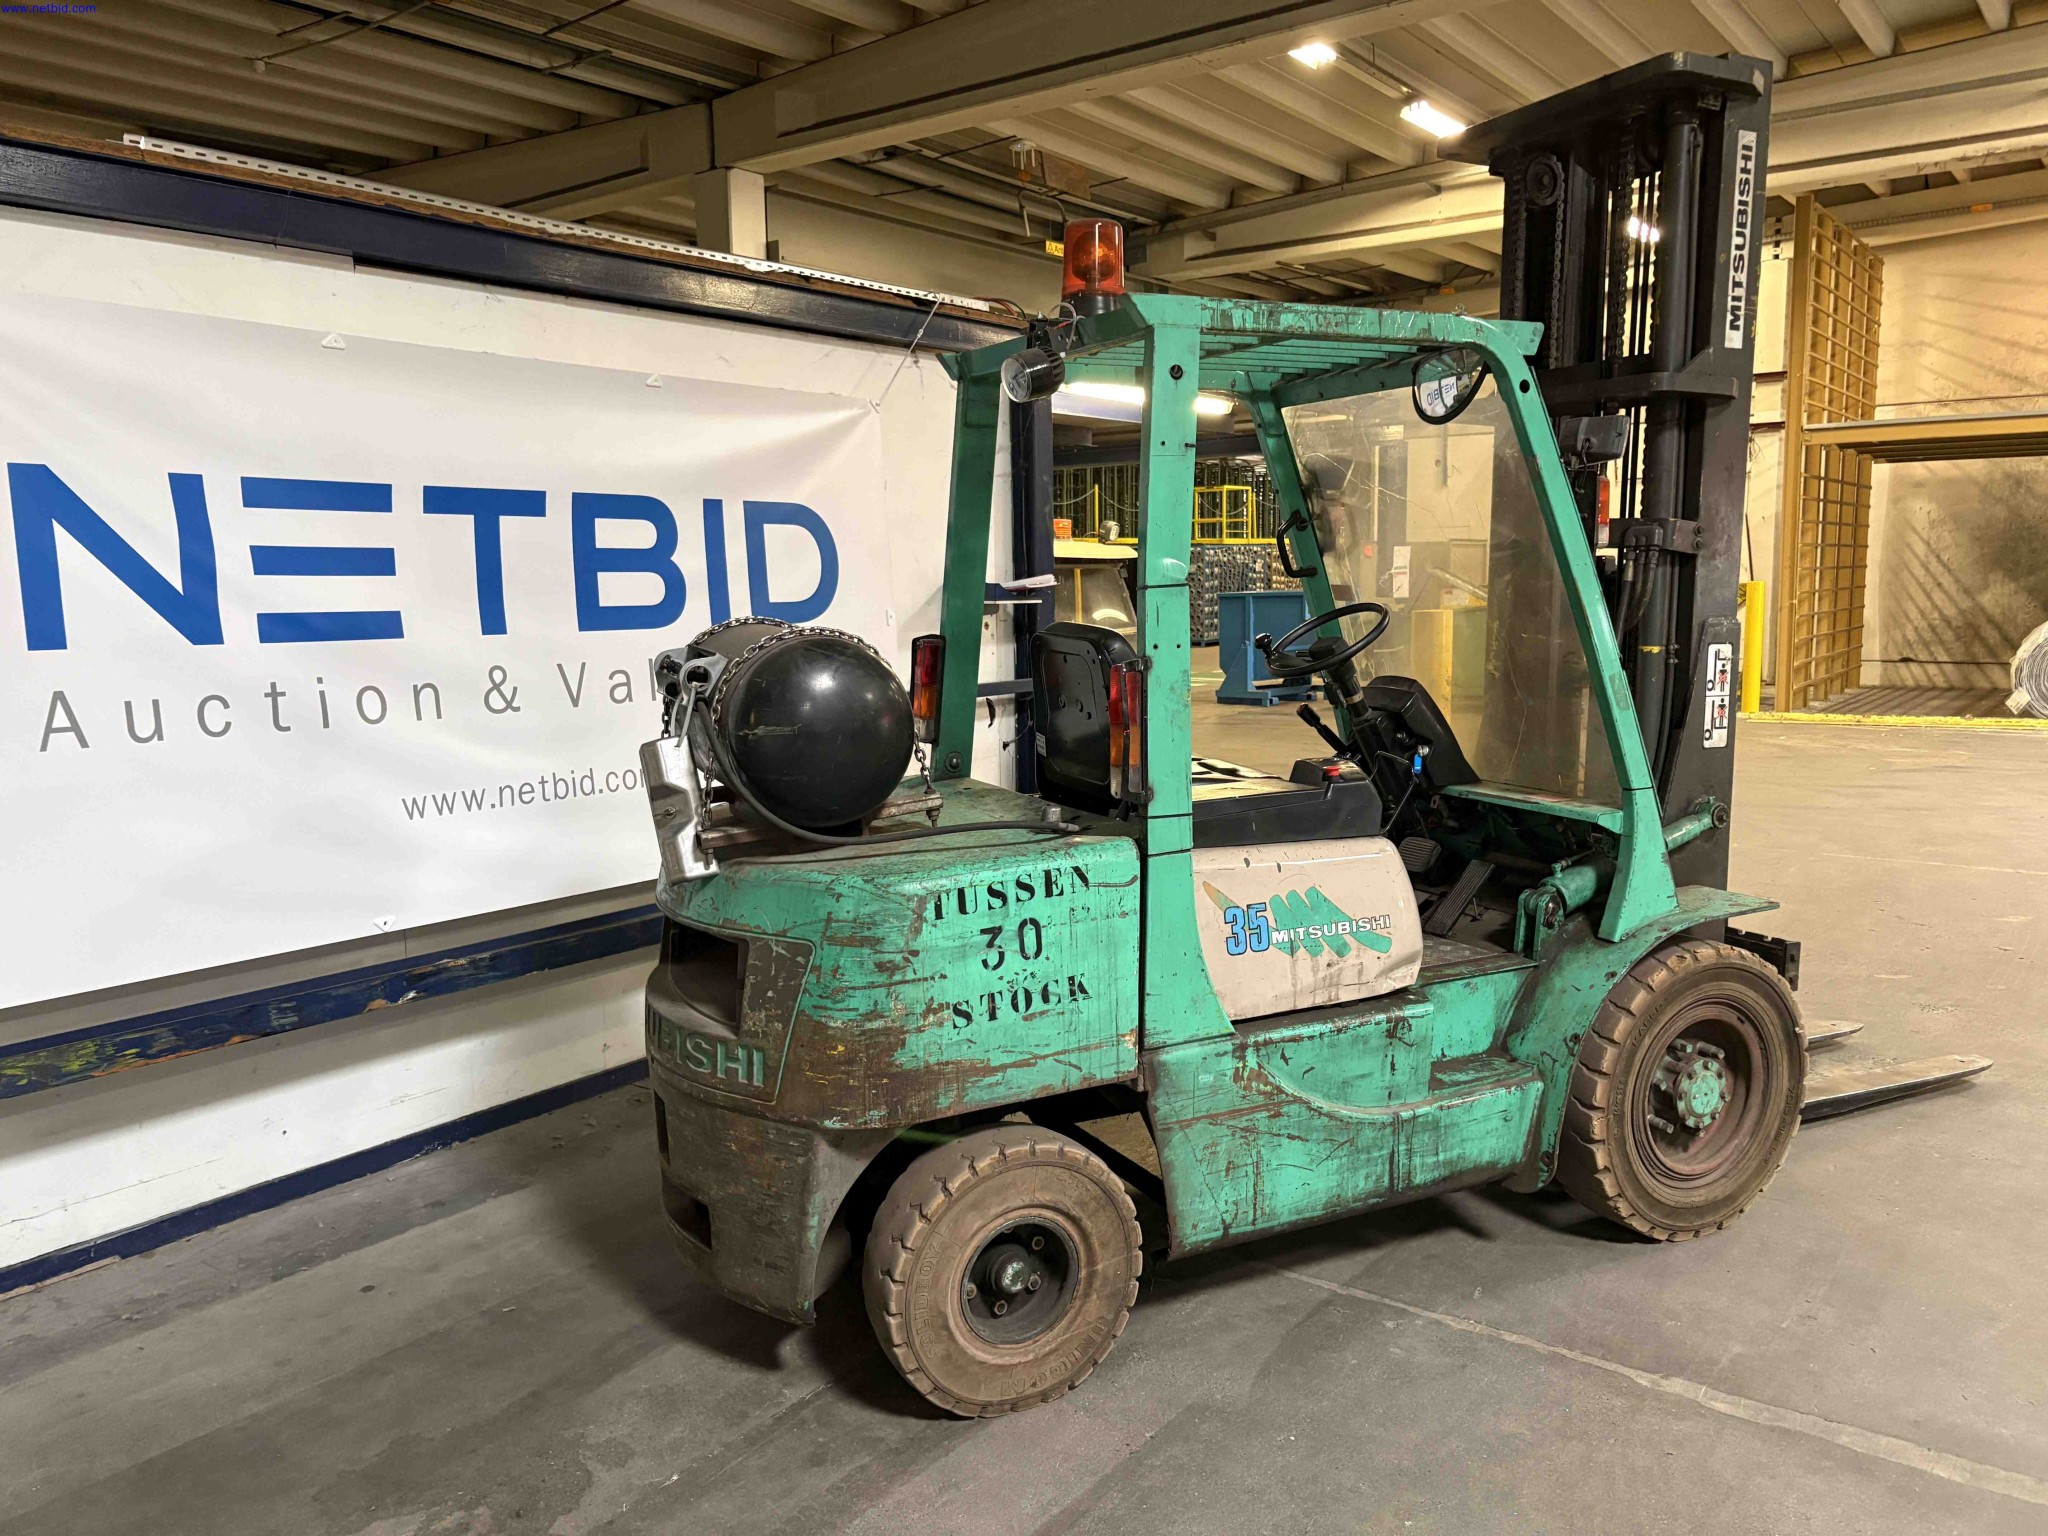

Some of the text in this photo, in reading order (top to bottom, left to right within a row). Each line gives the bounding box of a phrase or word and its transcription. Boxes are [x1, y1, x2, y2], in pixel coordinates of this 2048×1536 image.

[1729, 143, 1754, 332] MITSUBISHI
[7, 462, 840, 651] NETBID
[39, 677, 443, 752] Auction
[483, 664, 521, 714] &
[933, 862, 1091, 921] TUSSEN
[980, 917, 1043, 971] 30
[1224, 902, 1391, 956] 35 MITSUBISHI
[952, 973, 1093, 1029] STOCK
